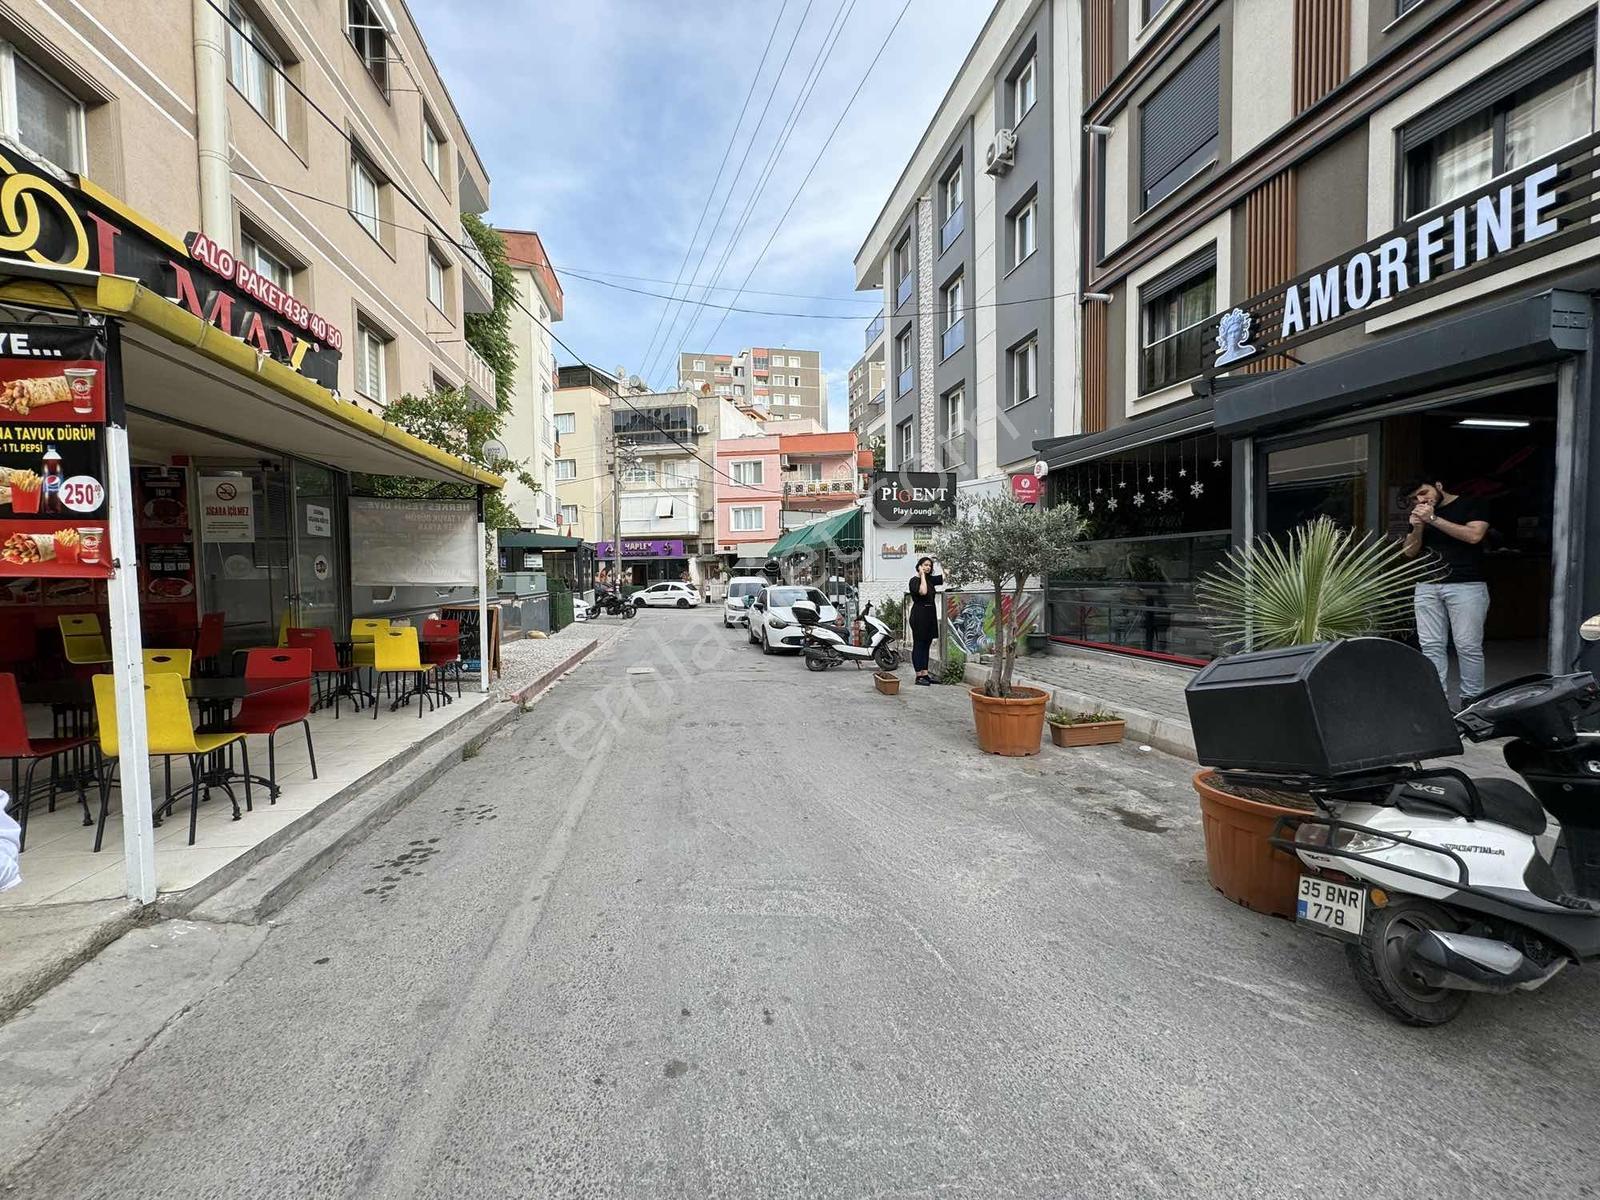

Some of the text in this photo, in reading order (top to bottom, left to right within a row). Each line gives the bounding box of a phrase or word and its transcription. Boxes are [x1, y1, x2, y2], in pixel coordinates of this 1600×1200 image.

[1281, 163, 1559, 338] AMORFINE
[192, 235, 233, 277] ALO
[310, 317, 326, 340] 40
[326, 328, 342, 350] 50
[15, 427, 55, 441] TAVUK
[57, 424, 96, 441] DÜRÜM
[20, 441, 43, 453] PEPSİ
[64, 483, 94, 505] 250
[893, 507, 909, 516] Play
[1301, 880, 1359, 909] 35 BNR
[1313, 902, 1345, 926] 778
